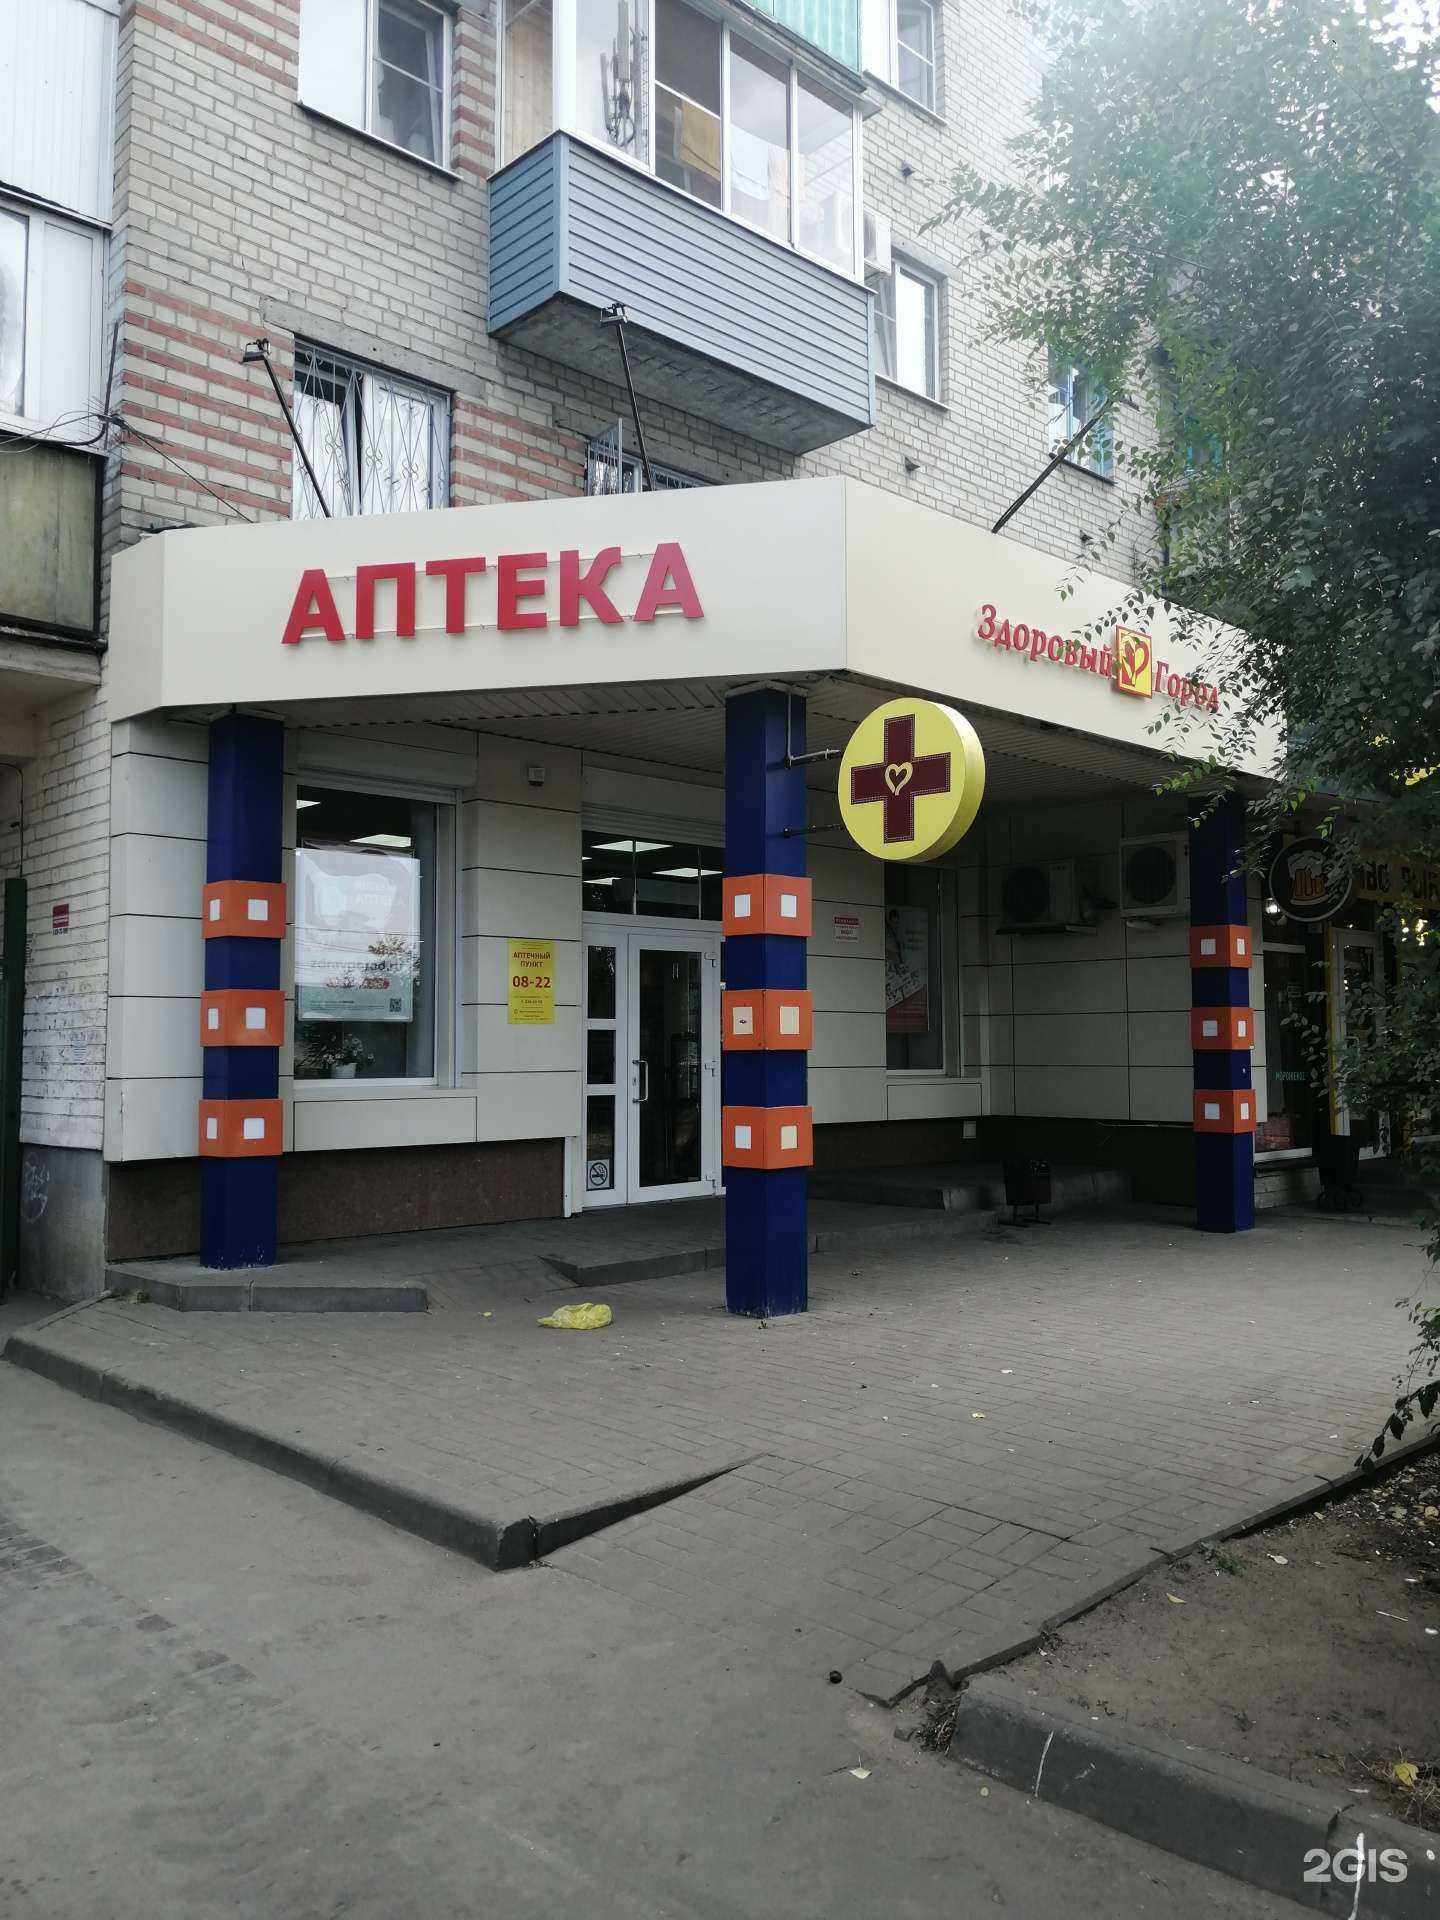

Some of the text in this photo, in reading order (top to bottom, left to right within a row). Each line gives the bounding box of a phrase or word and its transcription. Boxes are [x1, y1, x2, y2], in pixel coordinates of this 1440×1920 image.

[282, 542, 704, 645] АПТЕКА
[977, 603, 1113, 680] Здоровый
[513, 951, 551, 960] АПТЕЧНЫЙ
[520, 960, 544, 968] ПУНКТ
[512, 975, 551, 989] 08-22
